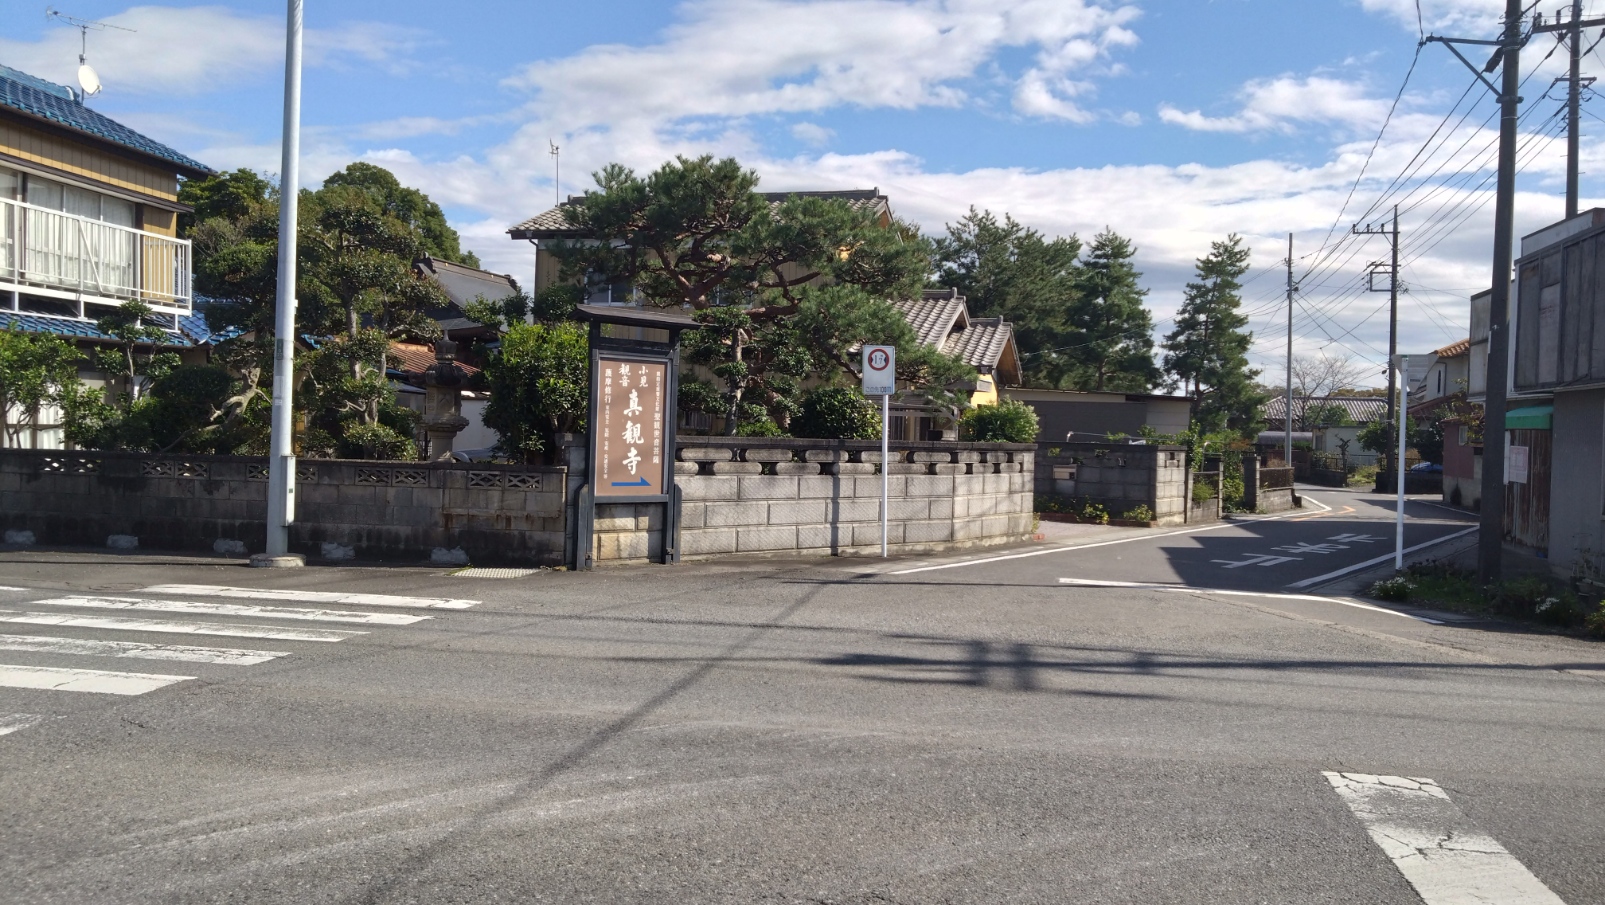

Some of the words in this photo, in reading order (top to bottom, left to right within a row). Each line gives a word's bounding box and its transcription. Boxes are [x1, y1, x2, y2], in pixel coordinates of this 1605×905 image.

[618, 363, 631, 387] 観音
[638, 365, 649, 387] 小見
[622, 388, 645, 476] 真観寺
[1209, 533, 1388, 569] 止まれ
